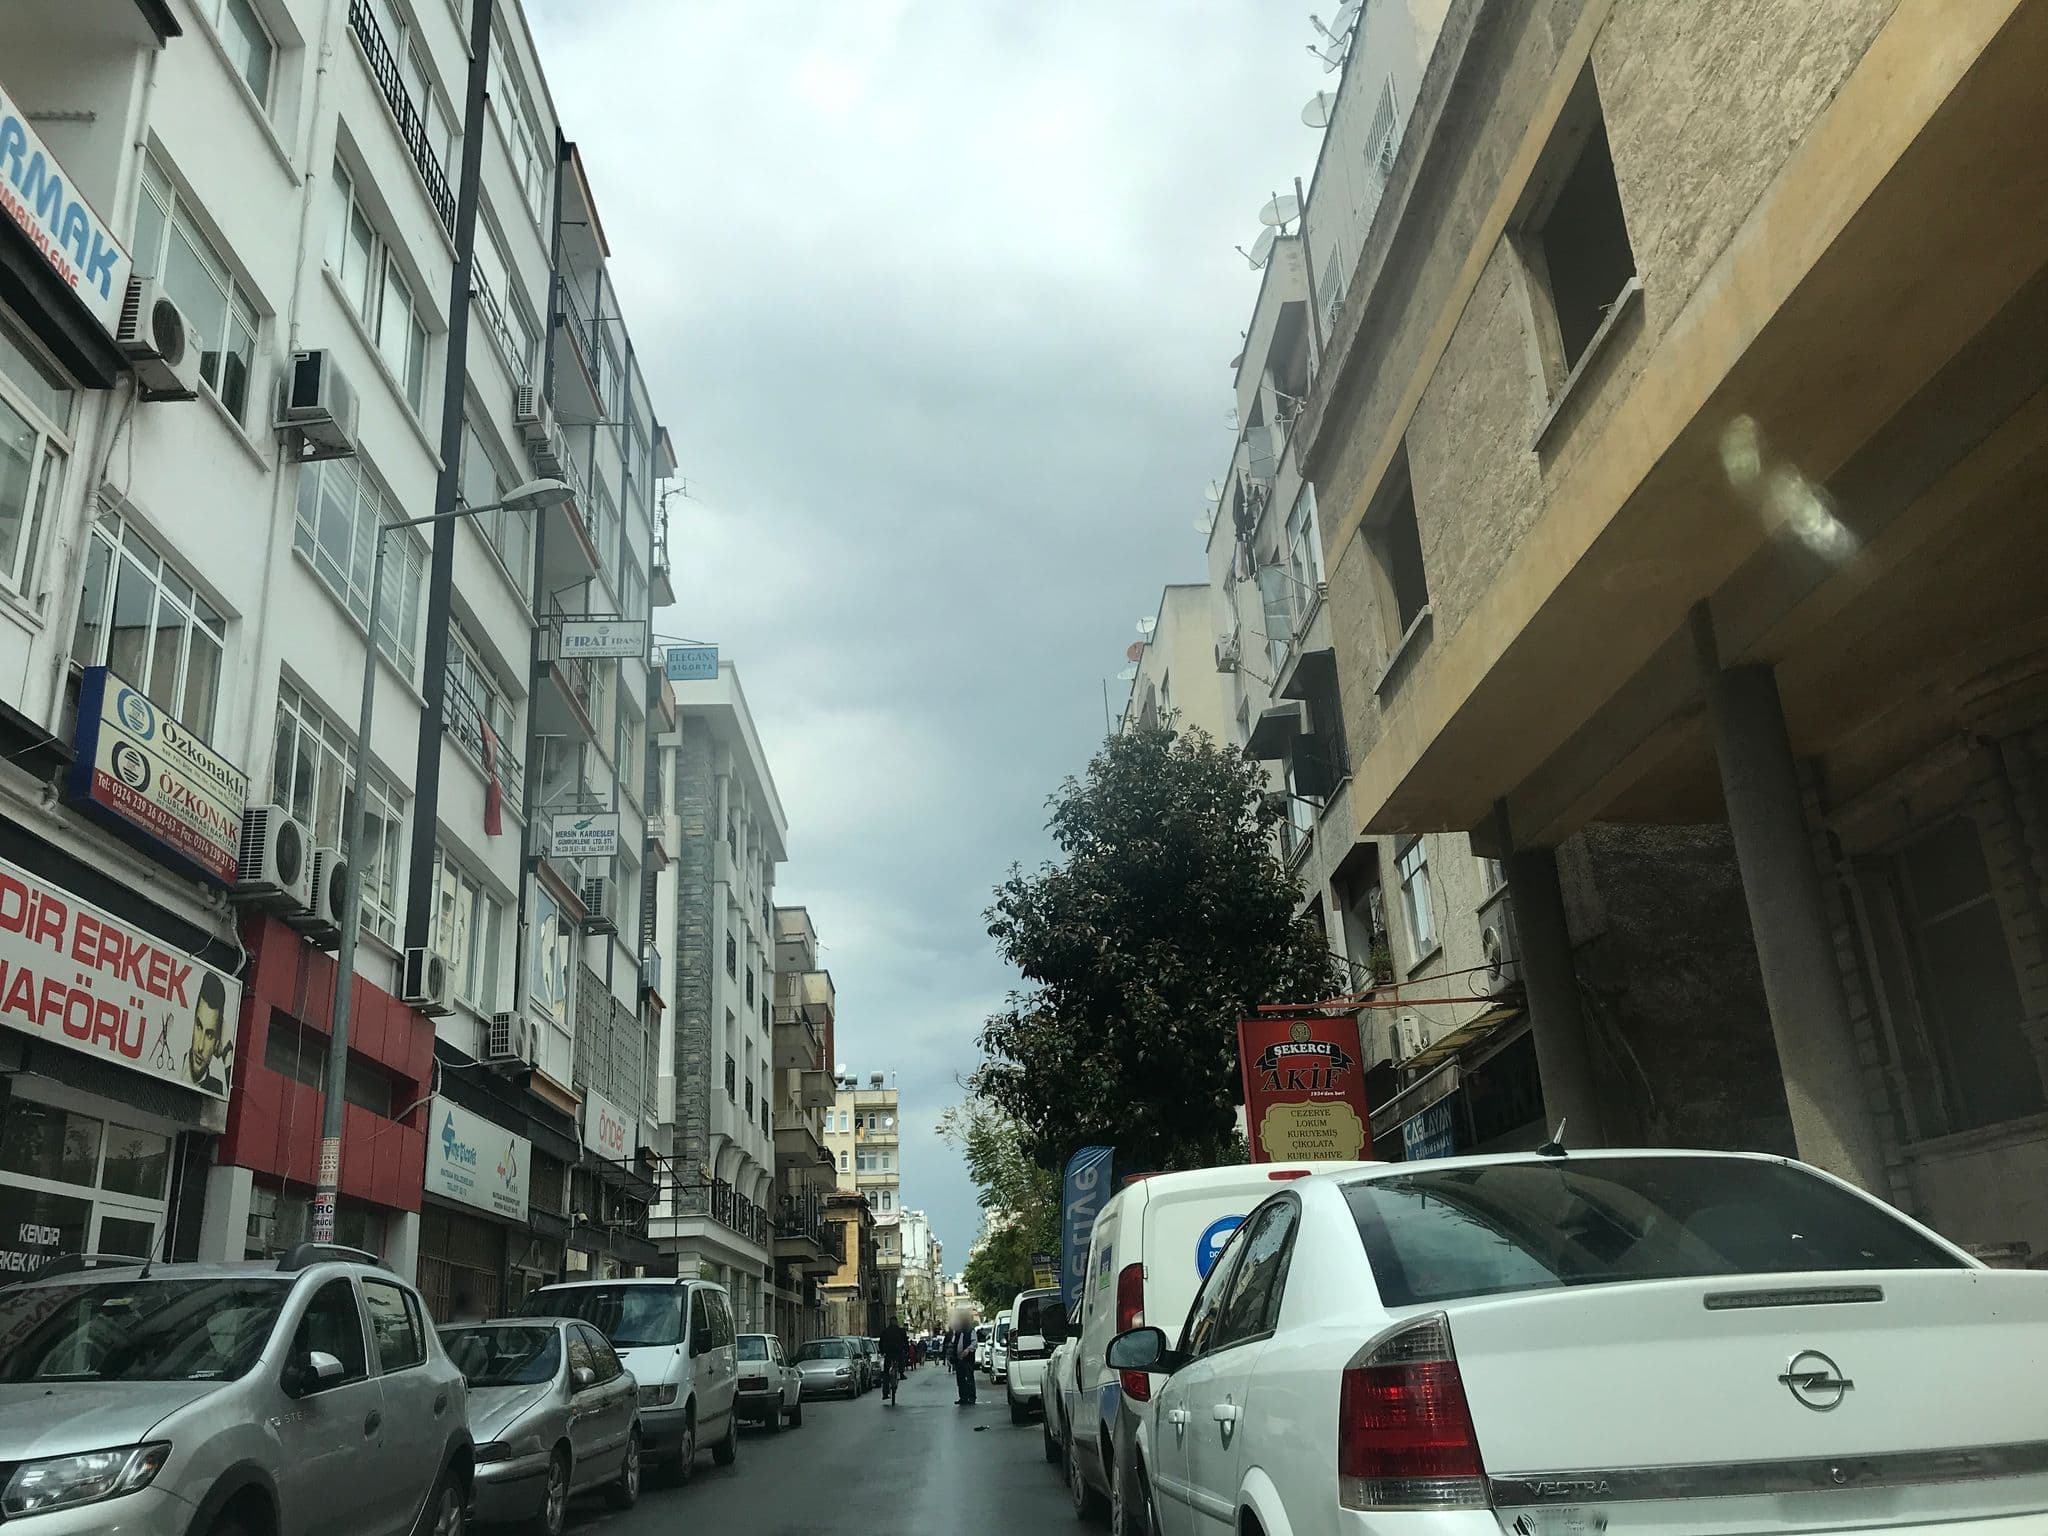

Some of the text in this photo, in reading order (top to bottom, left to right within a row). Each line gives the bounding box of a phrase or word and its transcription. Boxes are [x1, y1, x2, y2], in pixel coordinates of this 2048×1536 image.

[565, 635, 607, 647] FIRAT
[670, 652, 716, 662] ELEGANS
[161, 717, 244, 798] Özkonaklı
[112, 782, 131, 804] 0324
[132, 793, 147, 813] 239
[159, 769, 239, 844] ÖZKONAK
[71, 911, 193, 1010] ERKEK
[1273, 1042, 1332, 1058] ŞEKERCİ
[1261, 1062, 1342, 1092] AKİF
[1290, 1108, 1332, 1118] CEZERYE
[1296, 1119, 1328, 1128] LOKUM
[1287, 1128, 1338, 1139] KURUYEMİŞ
[1287, 1150, 1343, 1160] KURU KAHVE
[1525, 1480, 1613, 1496] VECTRA
